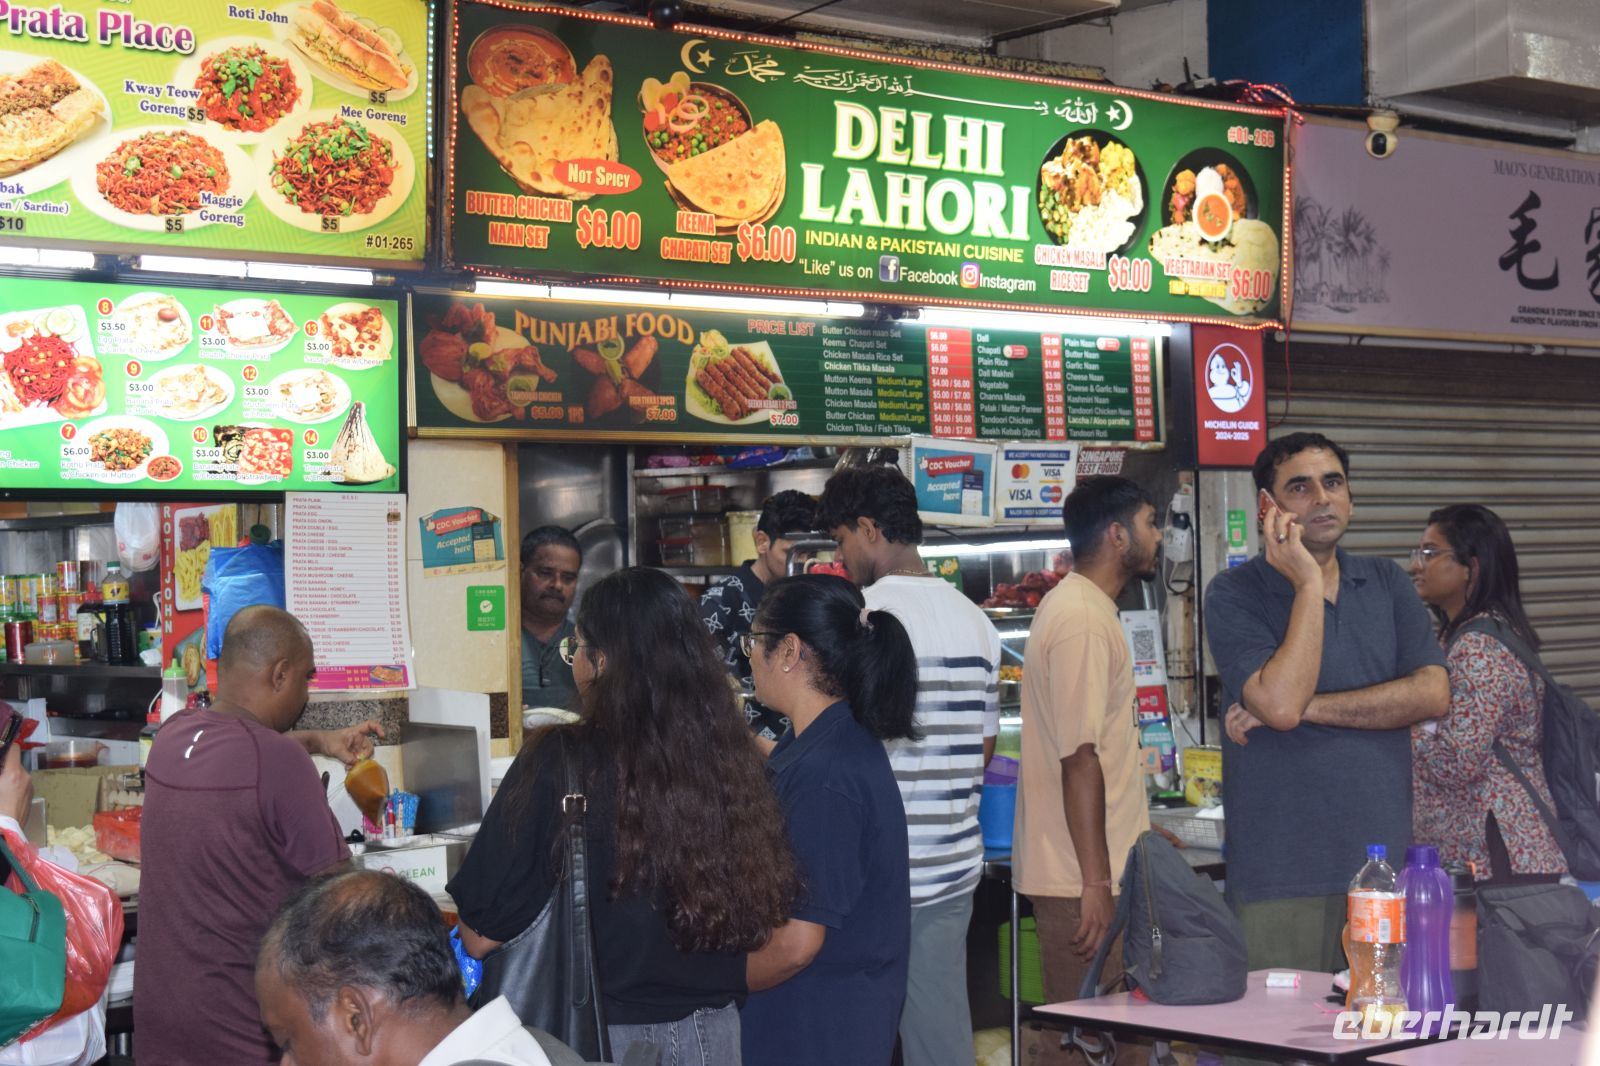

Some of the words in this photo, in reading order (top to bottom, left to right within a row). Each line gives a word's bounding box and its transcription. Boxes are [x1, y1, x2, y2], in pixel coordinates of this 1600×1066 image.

[229, 6, 256, 21] Roti
[259, 9, 288, 24] John
[99, 11, 193, 52] Place
[125, 81, 162, 98] Kway
[164, 84, 200, 99] Teow
[370, 91, 386, 104] $5
[140, 100, 186, 119] Goreng
[188, 108, 205, 122] $5
[341, 106, 365, 119] Mee
[368, 108, 407, 125] Goreng
[832, 100, 1005, 176] DELHI
[1494, 159, 1528, 178] MAO'S
[1529, 164, 1595, 186] GENERATION
[23, 201, 69, 214] Sardine)
[201, 193, 243, 209] Maggie
[466, 191, 515, 216] BUTTER
[517, 195, 573, 221] CHICKEN
[800, 163, 1031, 240] LAHORI
[165, 217, 183, 232] $5
[199, 209, 244, 226] Goreng
[321, 217, 338, 231] $5
[677, 212, 715, 235] KEEMA
[576, 205, 642, 250] $6.00
[366, 235, 414, 251] #01-265
[489, 223, 523, 247] NAAN
[526, 225, 550, 249] SET
[737, 223, 796, 263] $6.00
[661, 238, 709, 261] CHAPATI
[710, 241, 733, 263] SET
[805, 231, 863, 249] INDIAN
[866, 236, 877, 249] &
[881, 237, 961, 259] PAKISTANI
[964, 243, 1024, 263] CUISINE
[1035, 246, 1072, 265] CHICKEN
[1073, 249, 1106, 269] MASALA
[1109, 255, 1152, 292] $6.00
[1164, 258, 1216, 278] VEGETARIAN
[1217, 262, 1233, 280] SET
[838, 264, 854, 277] us
[857, 266, 873, 279] on
[900, 268, 959, 286] Facebook
[979, 272, 1036, 293] Instagram
[1050, 272, 1071, 290] RICE
[1072, 273, 1089, 292] SET
[1231, 269, 1272, 301] $6.00
[101, 322, 126, 332] $3.50
[514, 308, 618, 353] PUNJABI
[626, 312, 695, 346] FOOD
[747, 318, 785, 336] PRICE
[788, 320, 816, 337] LIST
[822, 326, 842, 335] Butter
[844, 327, 871, 337] Chicken
[890, 330, 901, 338] Set
[202, 337, 226, 347] $3.00
[307, 343, 330, 352] $3.00
[822, 338, 846, 346] Keema
[849, 339, 874, 350] Chapati
[875, 341, 887, 349] Set
[823, 350, 850, 359] Chicken
[851, 351, 875, 360] Masala
[876, 353, 891, 362] Rice
[892, 353, 903, 362] Set
[992, 358, 1008, 368] Rice
[824, 361, 851, 371] Chicken
[853, 362, 871, 372] Tikka
[872, 364, 895, 373] Masala
[824, 374, 848, 383] Mutton
[849, 375, 872, 385] Keema
[129, 383, 154, 392] $3.00
[246, 388, 269, 397] $3.00
[825, 386, 848, 396] Mutton
[849, 387, 873, 397] Masala
[825, 398, 852, 408] Chicken
[854, 399, 877, 409] Masala
[530, 406, 564, 420] $5.00
[646, 407, 678, 422] $7.00
[769, 413, 799, 426] $7.00
[825, 410, 846, 420] Butter
[847, 411, 875, 421] Chicken
[826, 423, 854, 432] Chicken
[855, 423, 873, 433] Tikka
[878, 424, 892, 433] Fish
[893, 424, 911, 434] Tikka
[1204, 420, 1237, 429] MICHELIN
[1238, 421, 1259, 430] GUIDE
[63, 447, 90, 456] $6.00
[196, 449, 220, 459] $3.00
[306, 451, 329, 460] $3.00
[1079, 450, 1125, 463] SINGAPORE
[929, 461, 943, 471] CDC
[944, 458, 971, 471] Voucher
[1077, 462, 1095, 474] BEST
[1097, 463, 1121, 474] FOODS
[1044, 468, 1061, 478] VISA
[927, 479, 961, 493] Accepted
[943, 491, 960, 502] here
[1008, 488, 1033, 501] VISA
[436, 520, 451, 531] CDC
[451, 513, 478, 527] Voucher
[163, 506, 171, 567] ROTI
[436, 533, 470, 550] Accepted
[454, 544, 471, 555] here
[165, 571, 173, 634] JOHN
